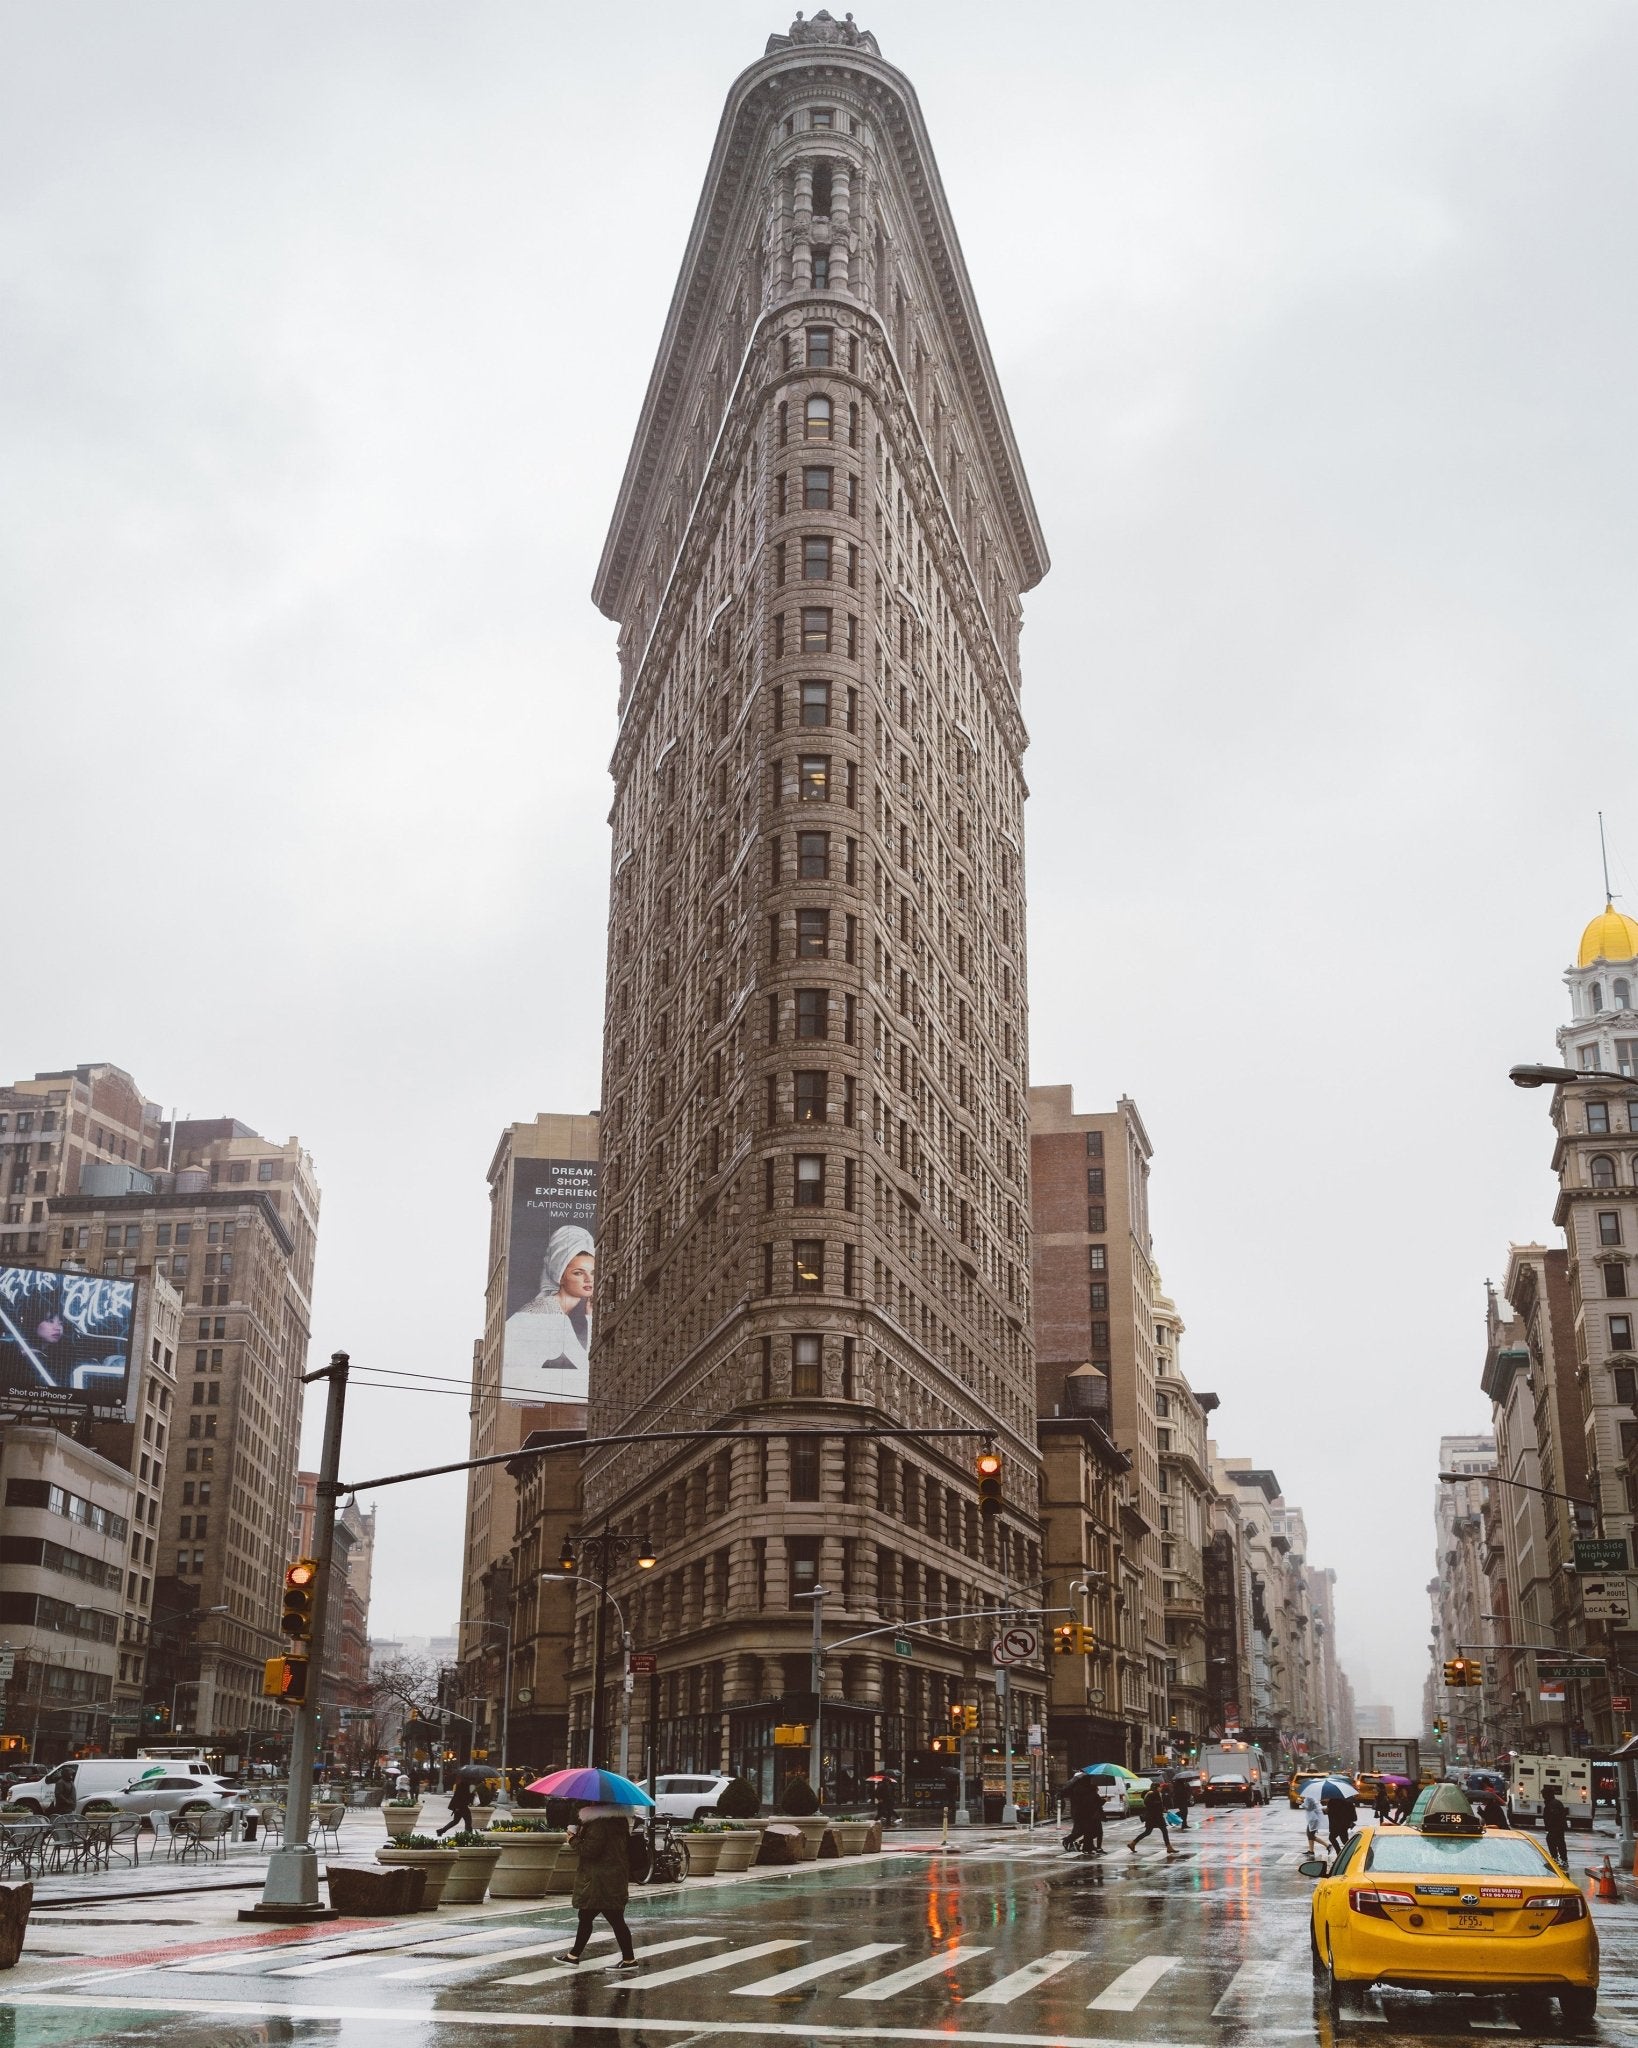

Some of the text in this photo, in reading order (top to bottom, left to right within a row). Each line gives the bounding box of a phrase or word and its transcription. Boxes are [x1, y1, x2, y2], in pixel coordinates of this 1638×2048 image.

[552, 1167, 597, 1176] DREAM.
[557, 1178, 590, 1186] SHOP.
[527, 1201, 573, 1209] FLATIRON
[550, 1210, 570, 1218] MAY
[9, 1388, 27, 1396] Shot
[40, 1390, 67, 1400] iPhone
[1603, 1542, 1624, 1550] Side
[1580, 1551, 1621, 1560] Highway
[1553, 1668, 1590, 1676] W 23 St
[1440, 1814, 1462, 1823] 2F55
